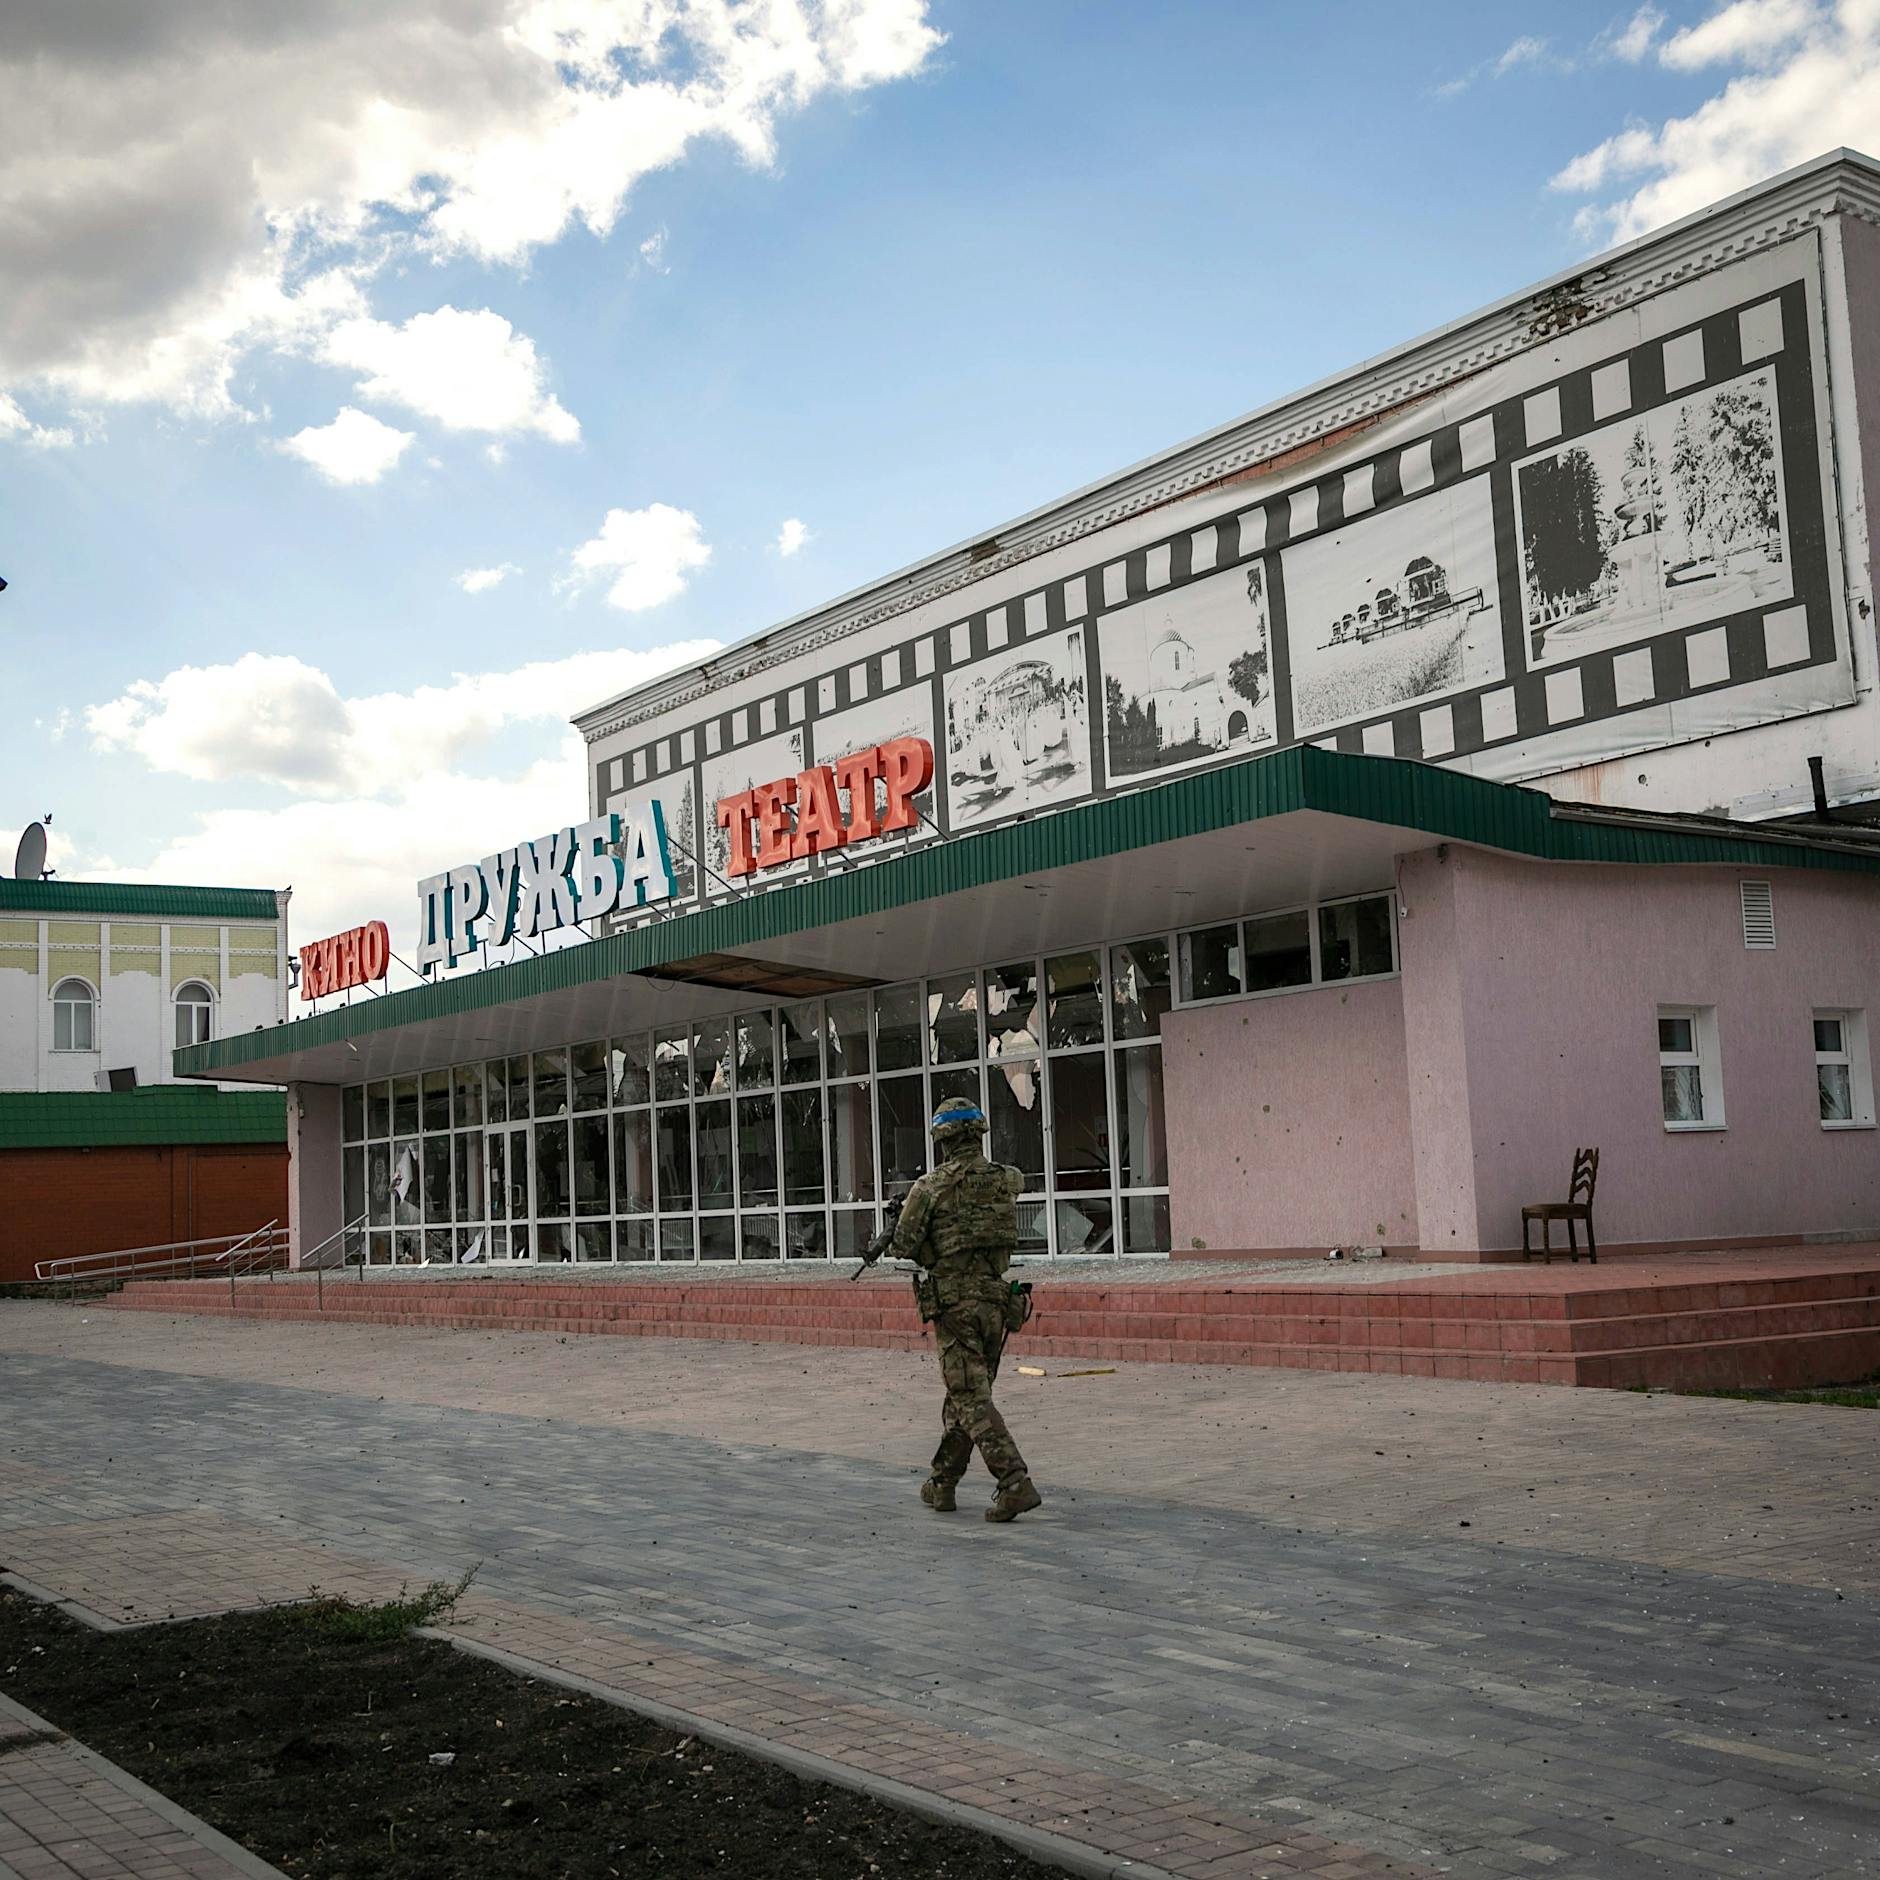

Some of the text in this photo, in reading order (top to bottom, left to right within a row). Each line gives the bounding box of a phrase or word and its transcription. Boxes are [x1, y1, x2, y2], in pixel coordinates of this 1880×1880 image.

[299, 737, 933, 1001] КИНО ДРУЖБА ТЕАТР
